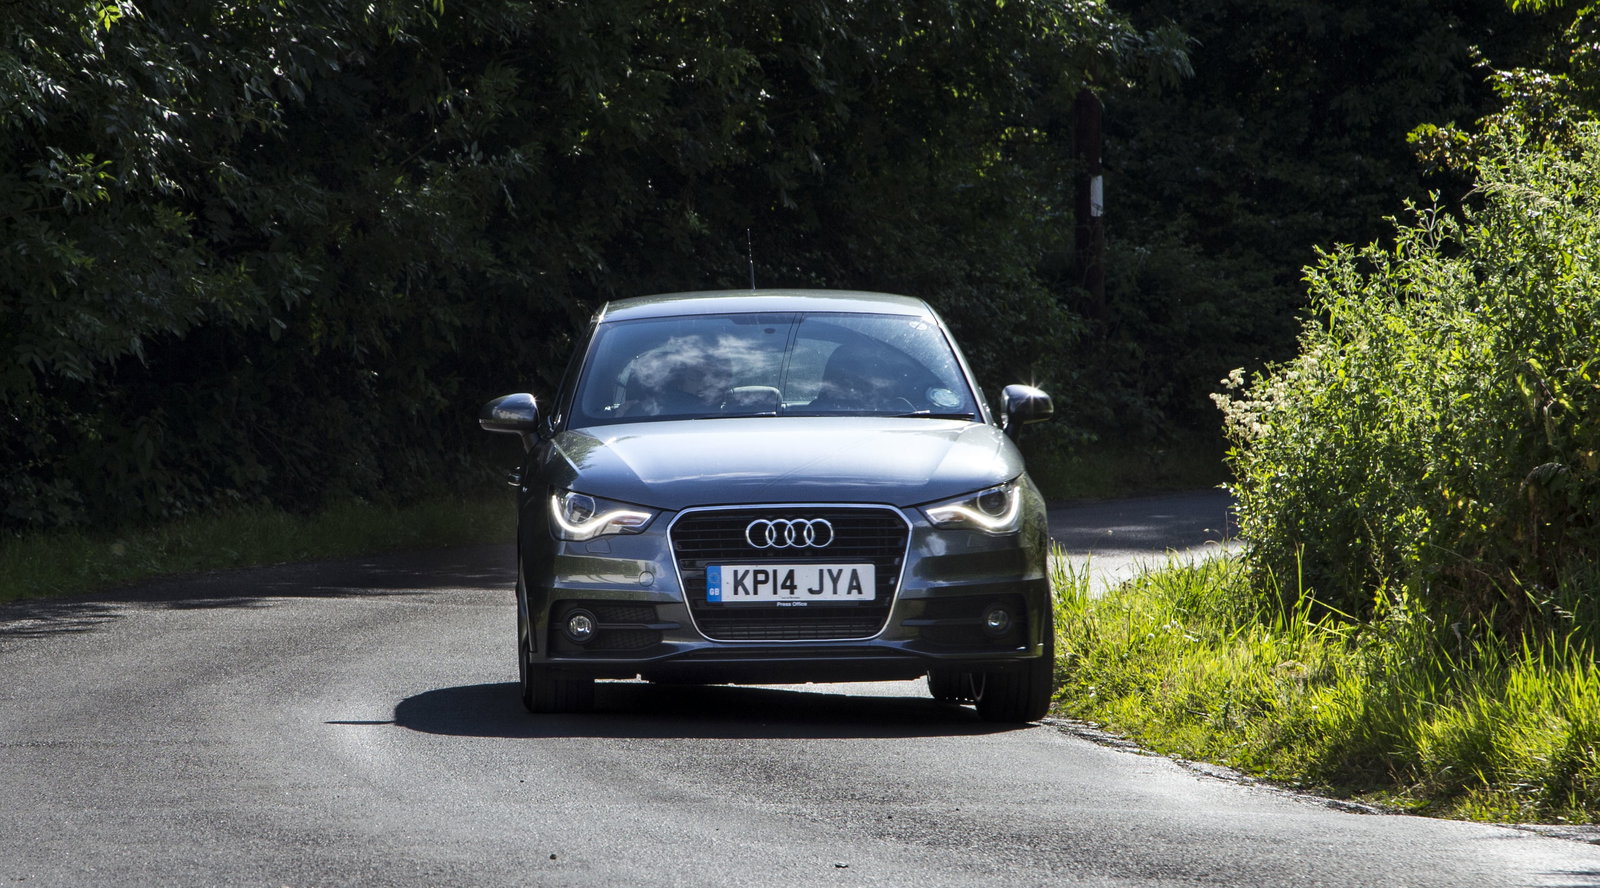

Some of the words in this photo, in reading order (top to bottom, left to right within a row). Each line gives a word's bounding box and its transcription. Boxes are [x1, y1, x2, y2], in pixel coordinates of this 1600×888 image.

[733, 569, 798, 596] KP14
[807, 568, 863, 595] JYA
[709, 587, 720, 596] GB
